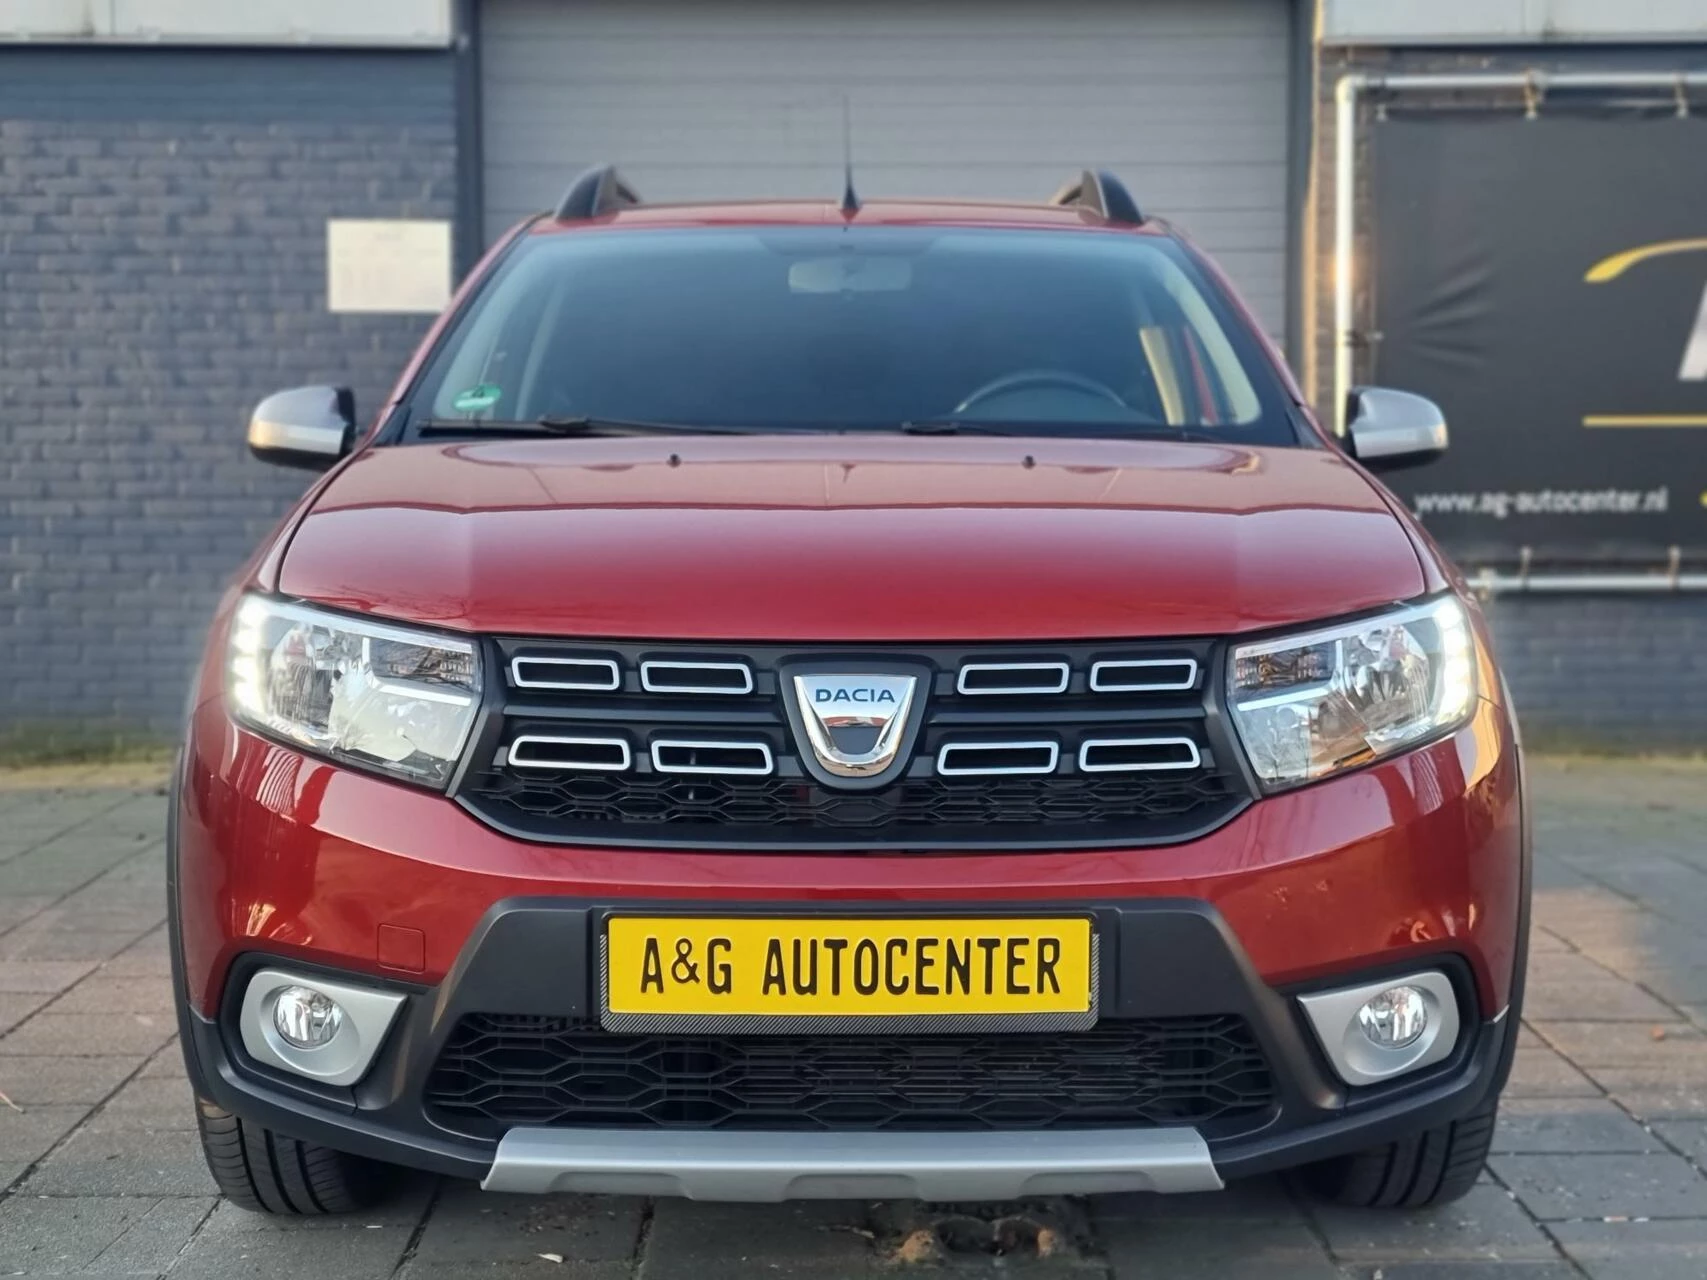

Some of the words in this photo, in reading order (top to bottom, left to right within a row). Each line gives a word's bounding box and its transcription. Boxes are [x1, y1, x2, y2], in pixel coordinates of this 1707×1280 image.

[1415, 487, 1668, 518] www.ag-autocenter.nl
[815, 688, 895, 703] DACIA
[640, 936, 732, 995] A&G
[762, 937, 1061, 996] AUTOCENTER
